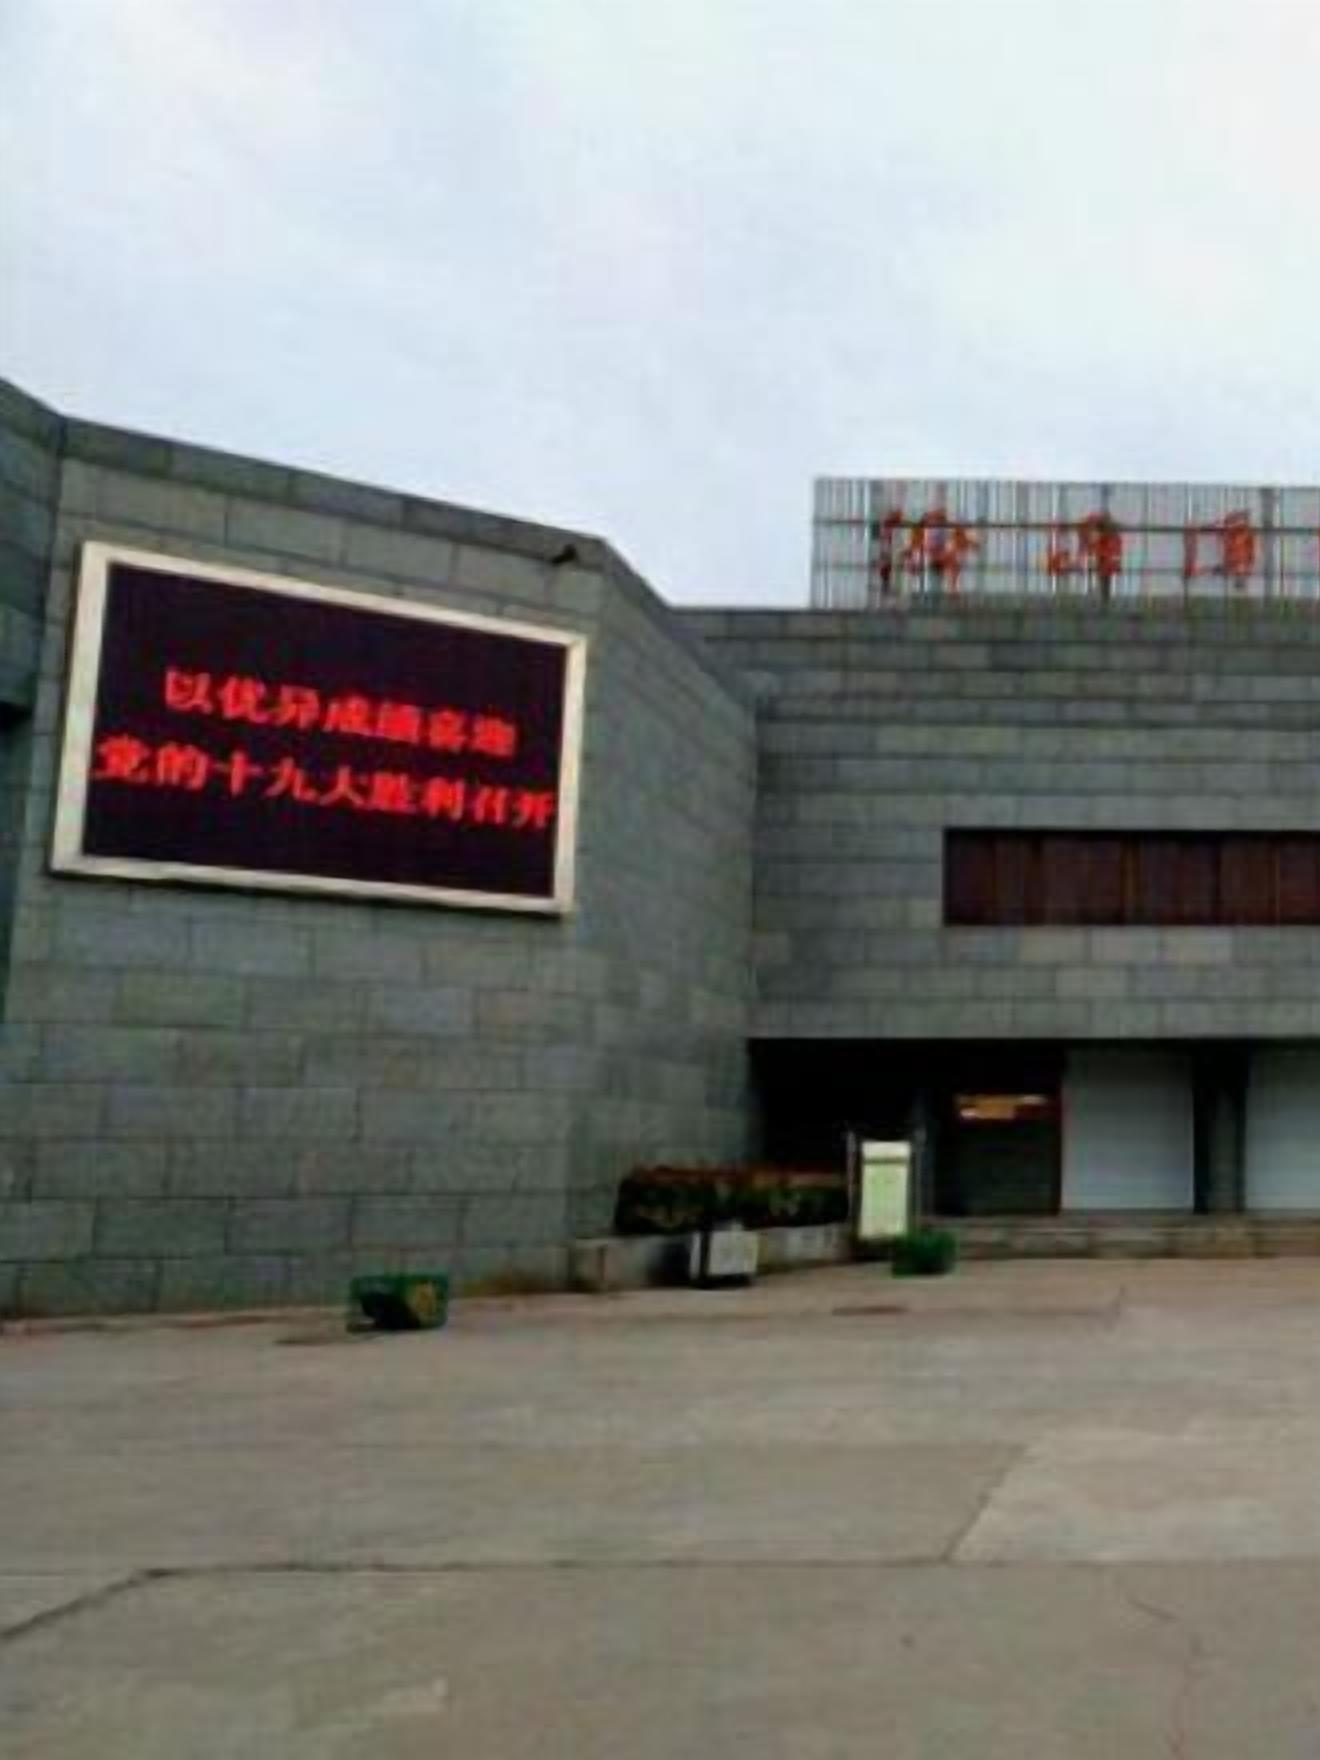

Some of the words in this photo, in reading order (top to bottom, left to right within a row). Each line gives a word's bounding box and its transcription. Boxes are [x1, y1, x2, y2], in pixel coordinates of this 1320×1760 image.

[94, 733, 556, 829] 党的十九大胜利召开
